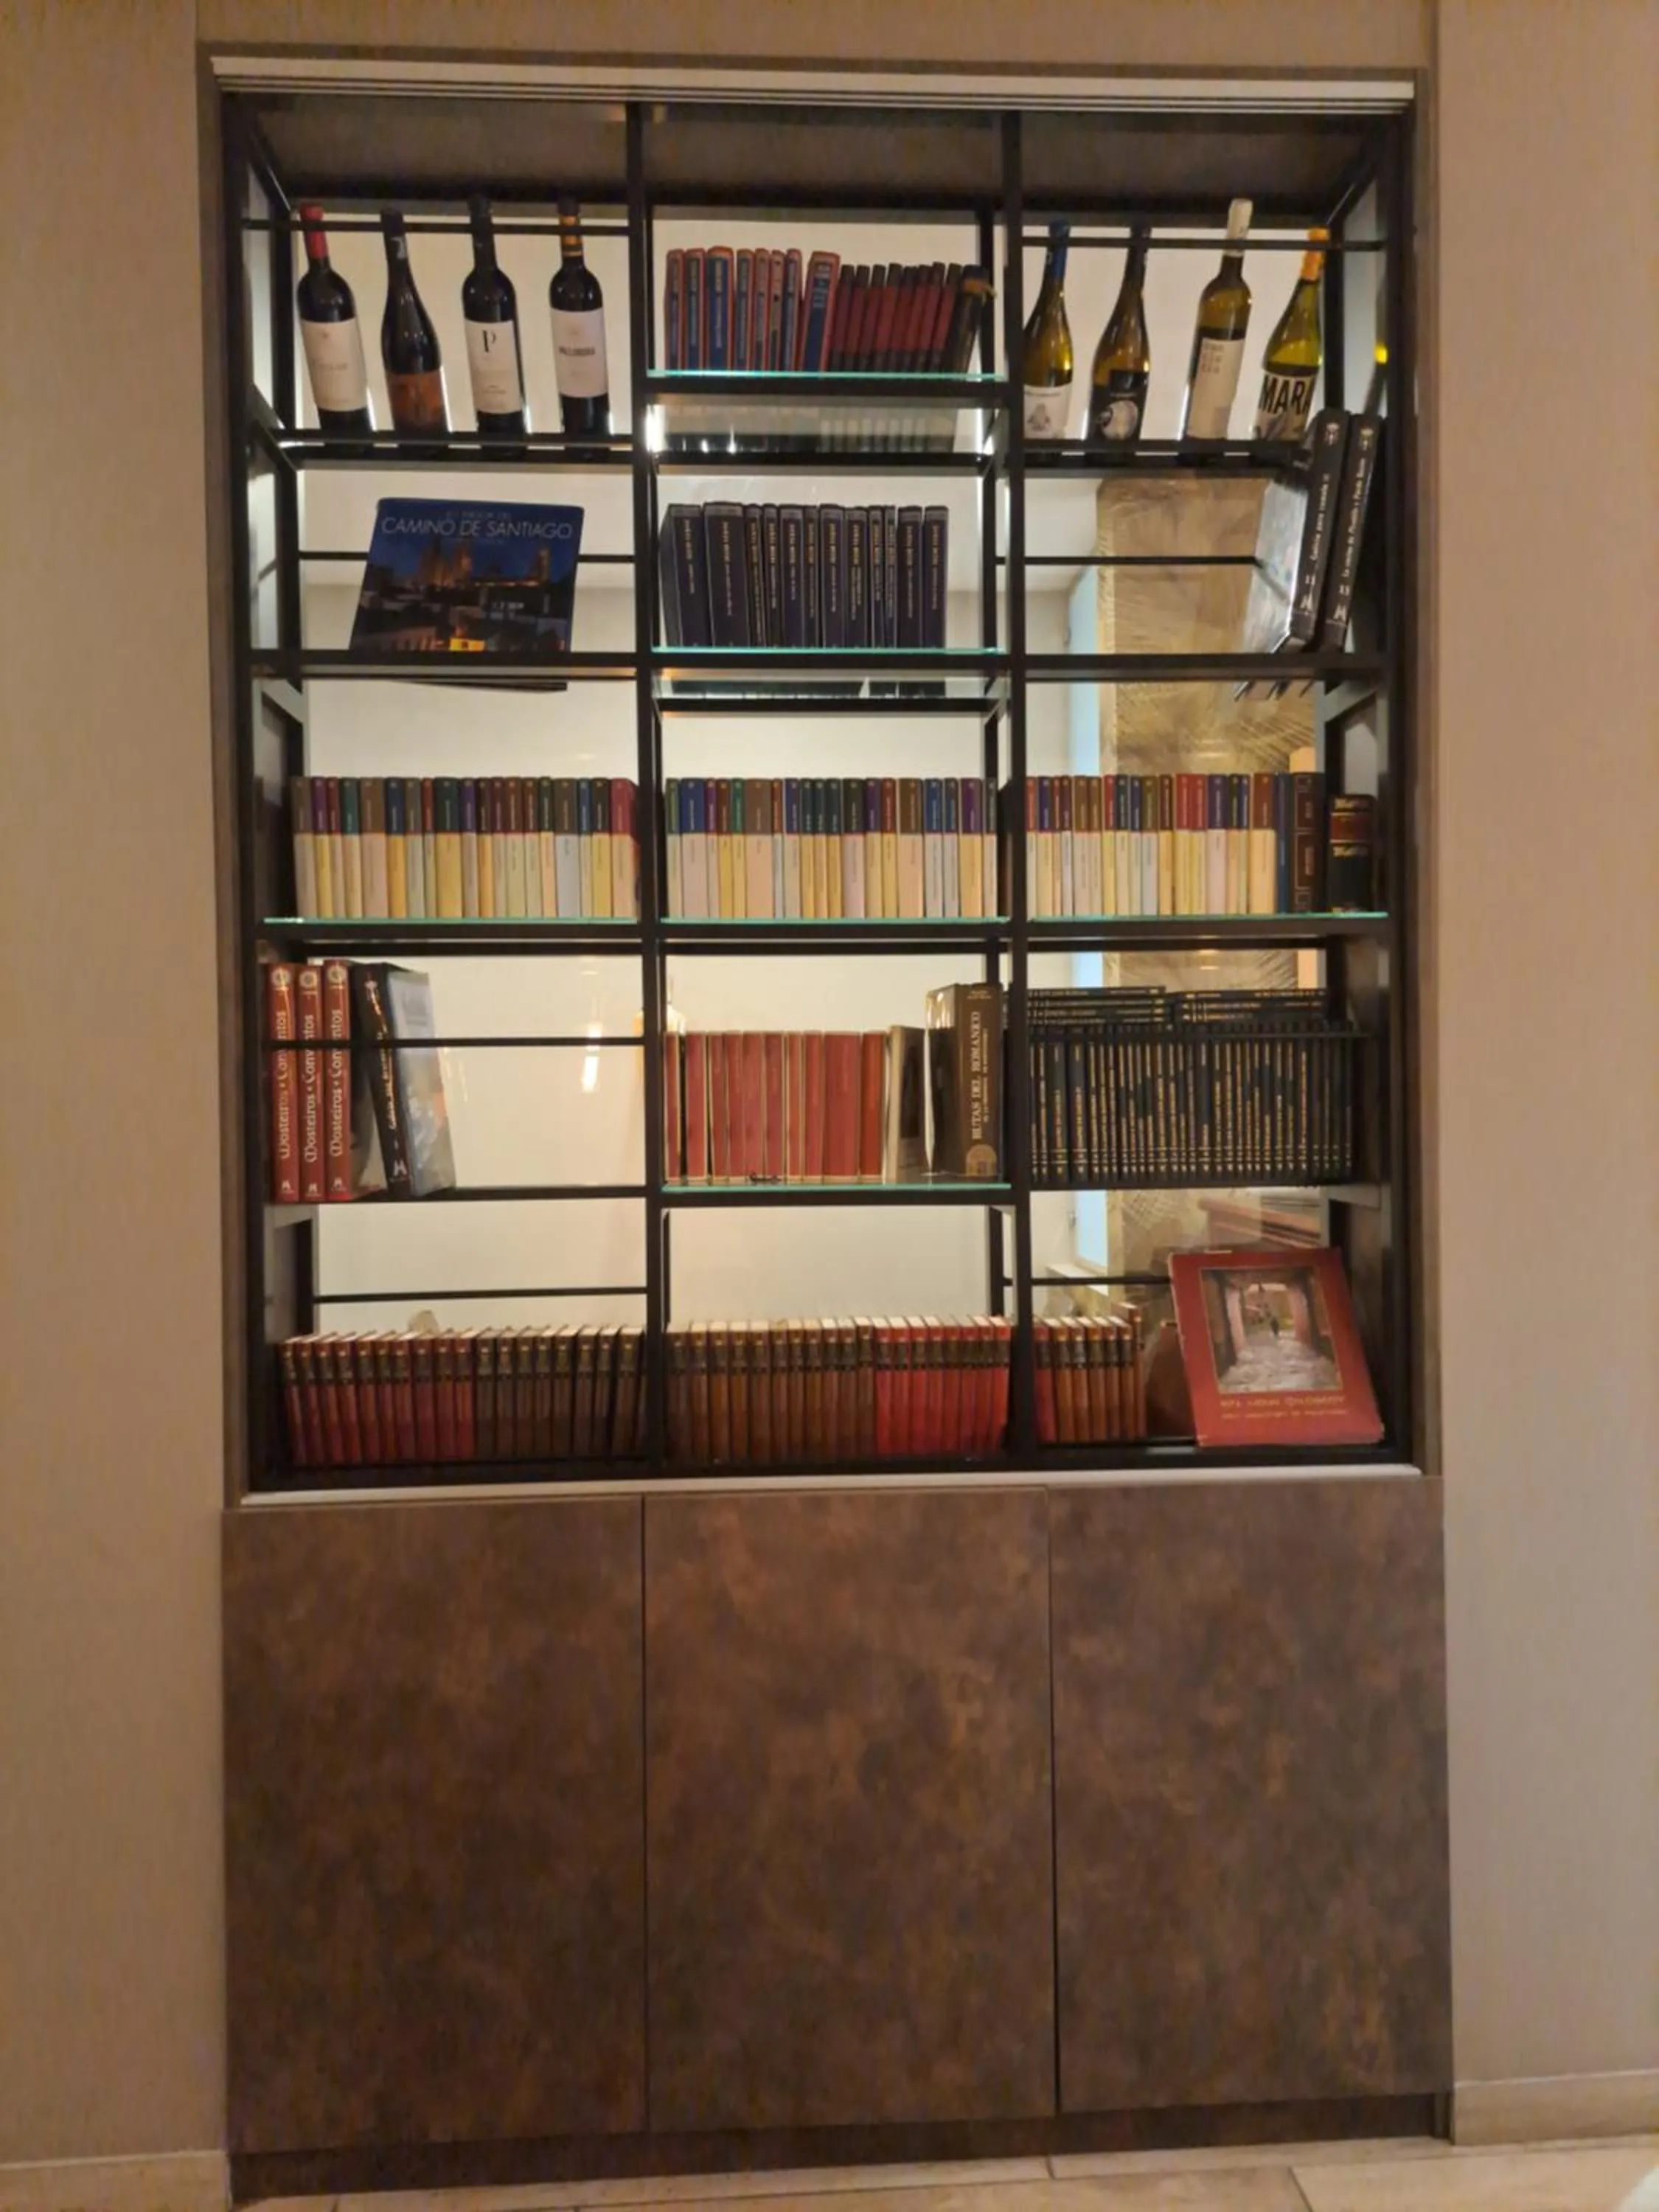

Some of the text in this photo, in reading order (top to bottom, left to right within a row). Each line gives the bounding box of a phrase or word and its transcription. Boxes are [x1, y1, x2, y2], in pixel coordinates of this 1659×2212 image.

[380, 518, 574, 540] CAMINO DE SANTIAGO
[276, 1011, 290, 1159] Mosteiros Convntos
[302, 1014, 317, 1163] Mosteiros Convntos
[330, 1009, 343, 1157] Mosteiros Conntos
[971, 1101, 981, 1140] RUTAS
